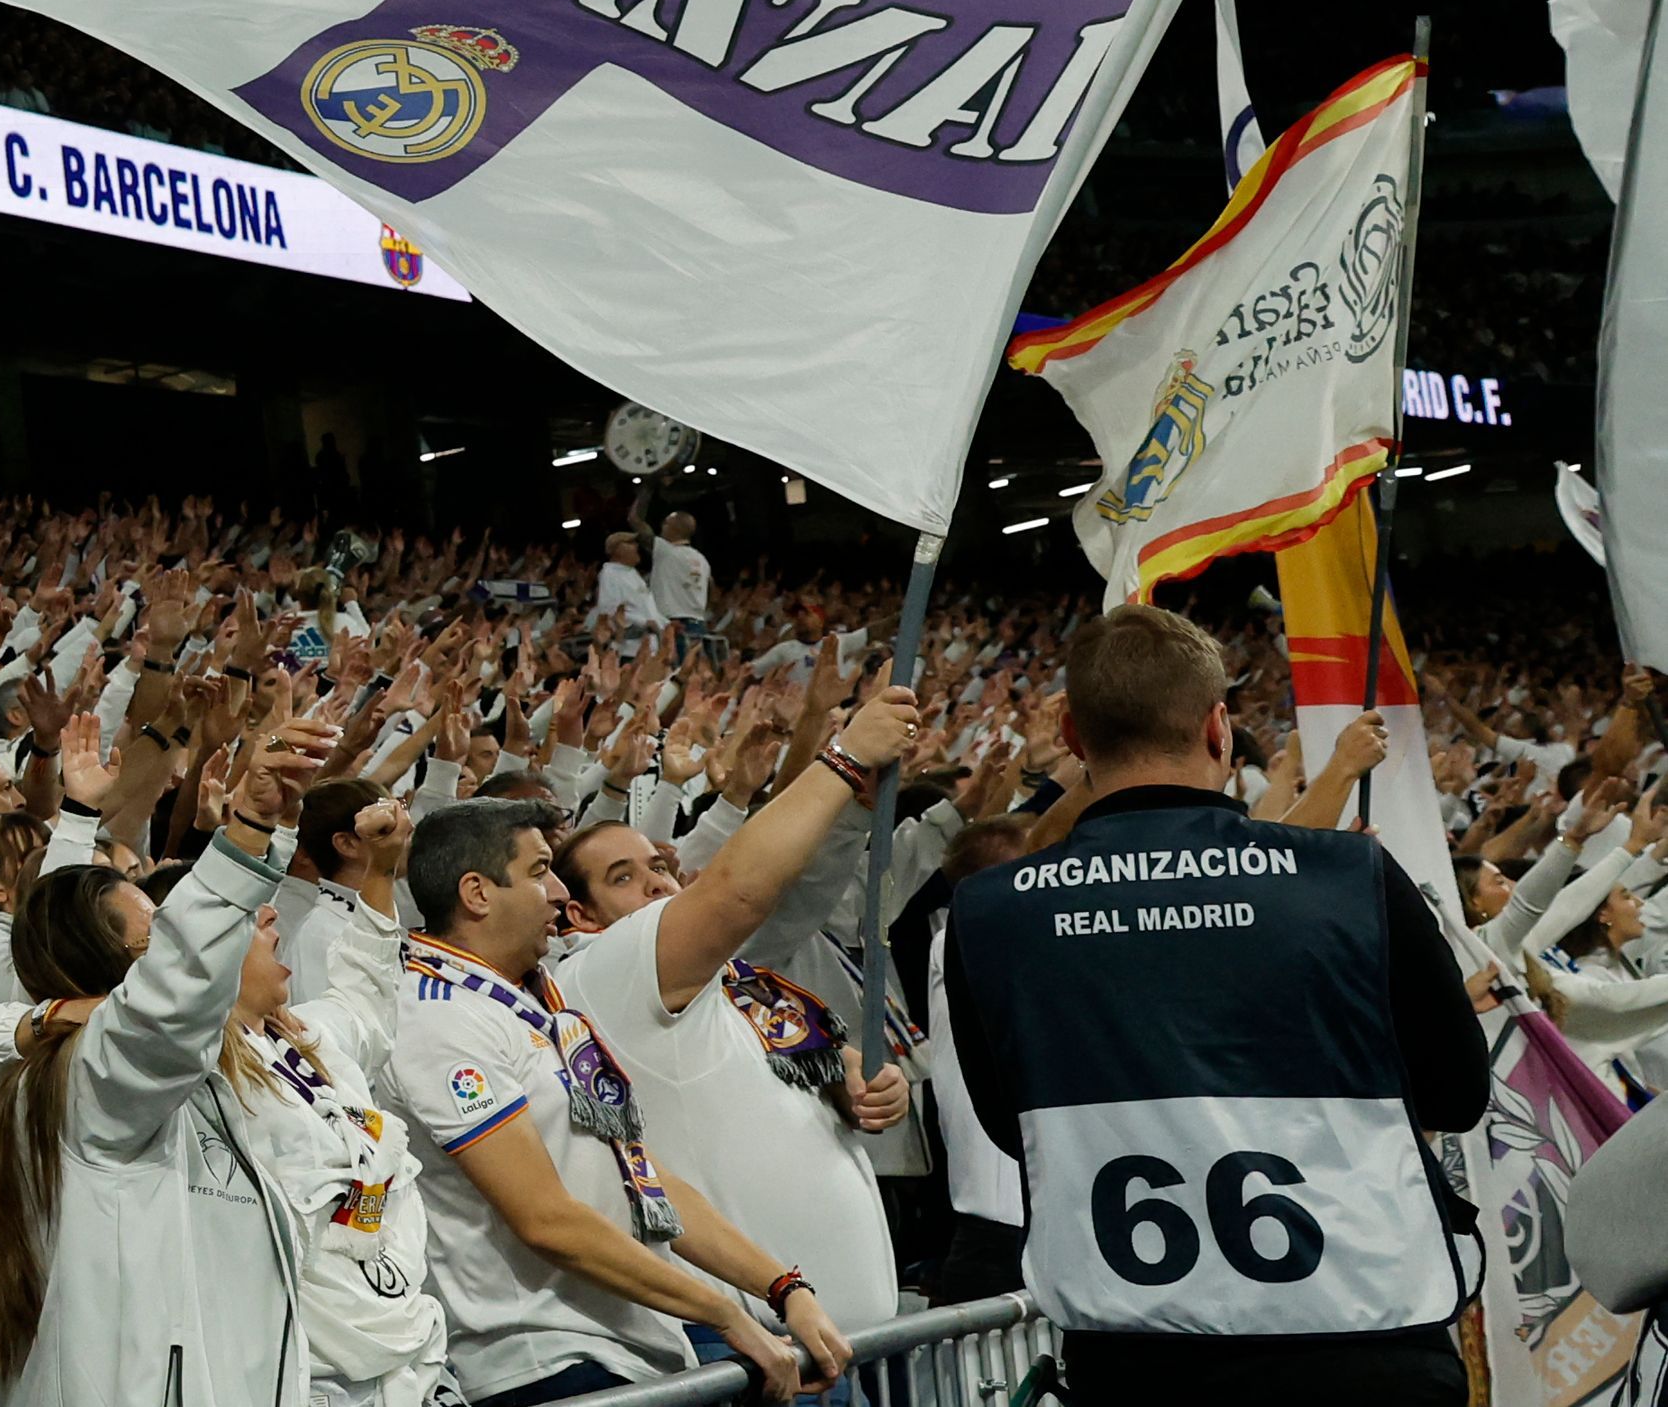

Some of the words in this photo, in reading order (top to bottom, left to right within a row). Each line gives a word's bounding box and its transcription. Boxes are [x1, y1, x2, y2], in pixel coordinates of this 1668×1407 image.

[61, 145, 287, 251] BARCELONA
[1402, 368, 1449, 420] RID
[1013, 842, 1298, 892] ORGANIZACIÓN
[1053, 909, 1130, 937] REAL
[1137, 902, 1256, 932] MADRID
[461, 1096, 495, 1115] LaLiga
[1090, 1150, 1326, 1286] 66
